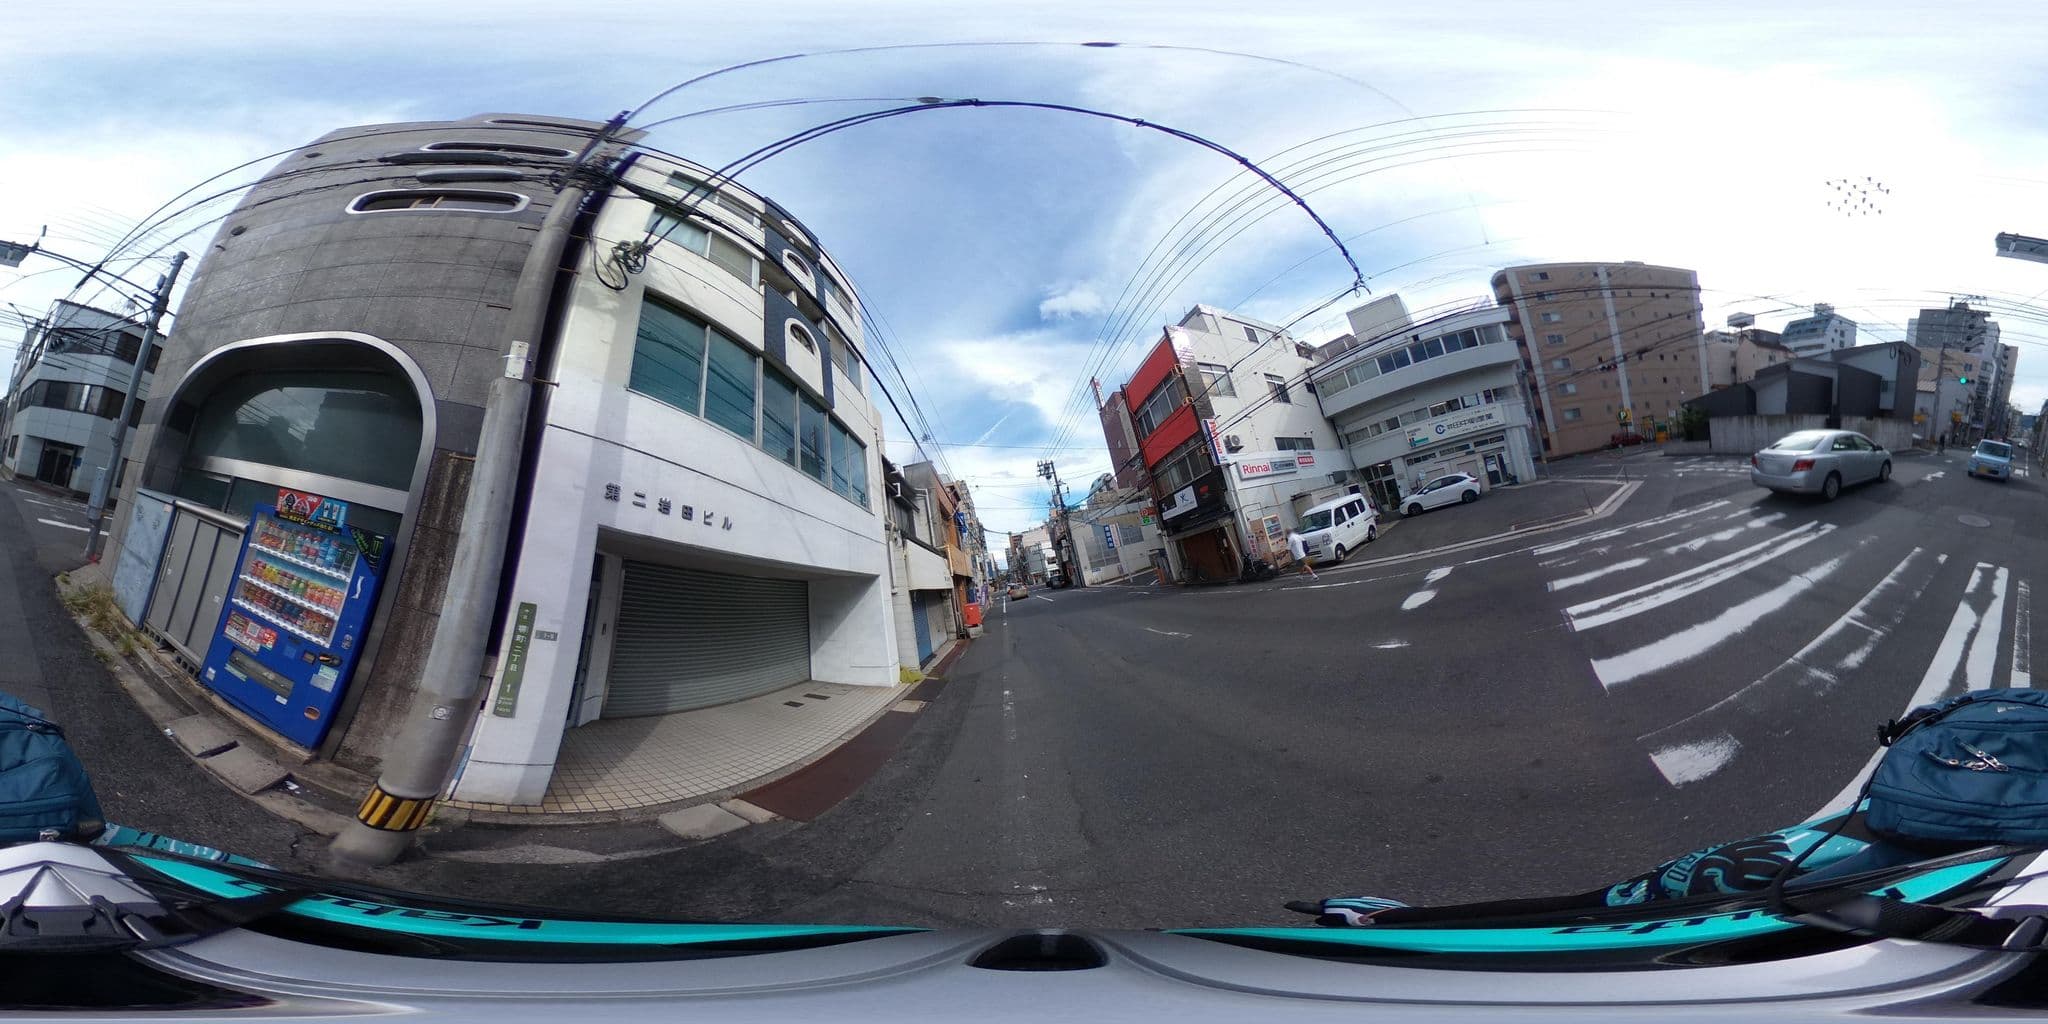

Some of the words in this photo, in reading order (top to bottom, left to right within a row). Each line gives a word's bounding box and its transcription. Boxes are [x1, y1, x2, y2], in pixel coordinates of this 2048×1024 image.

[1242, 462, 1270, 475] Rinnai
[604, 482, 733, 531] 第二岩田ビル
